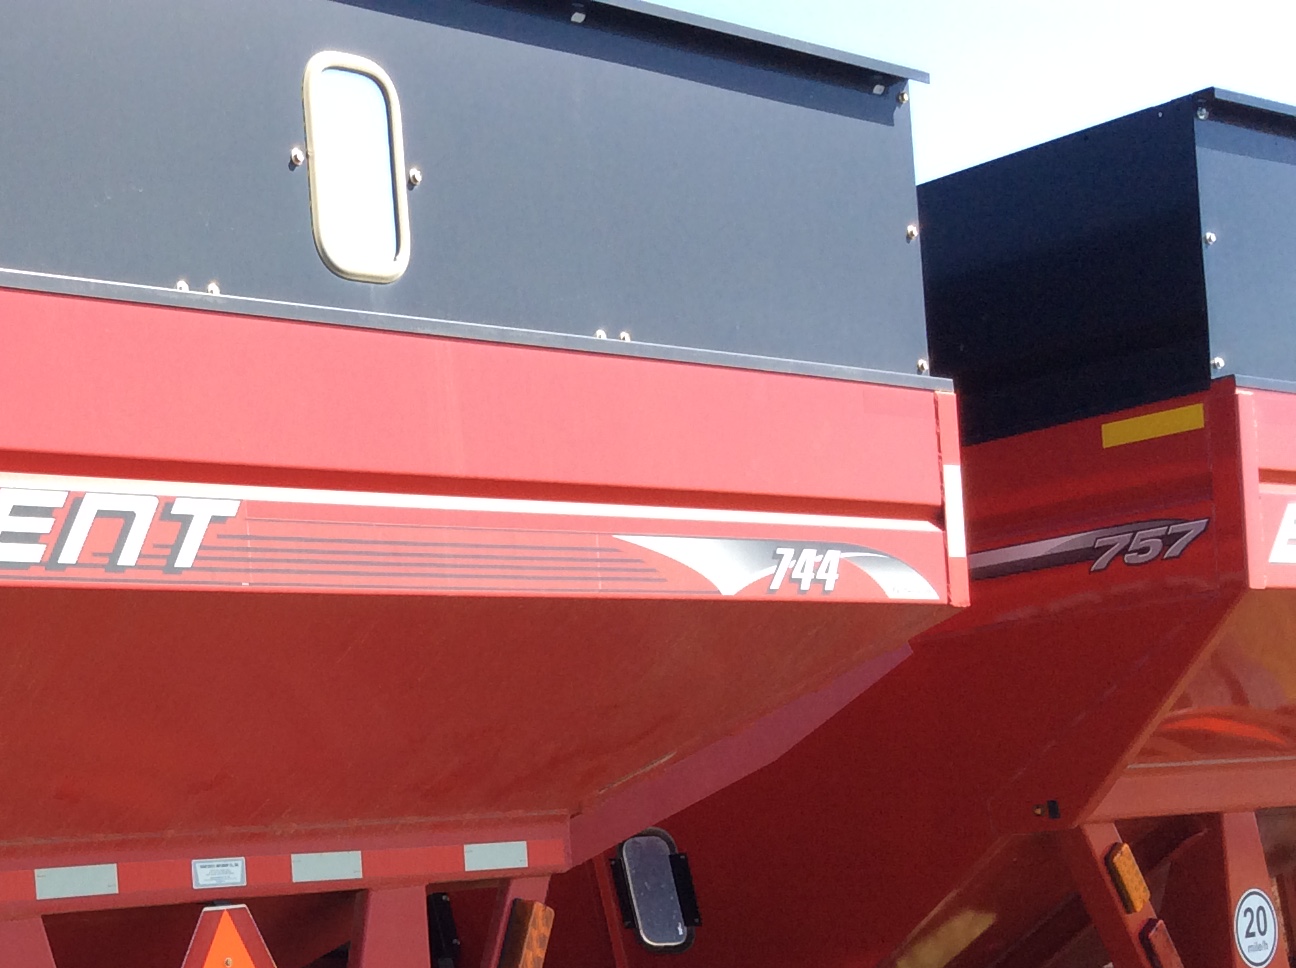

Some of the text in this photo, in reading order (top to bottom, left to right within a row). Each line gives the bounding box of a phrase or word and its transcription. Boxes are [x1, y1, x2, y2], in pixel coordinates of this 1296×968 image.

[1089, 518, 1210, 574] 757
[766, 547, 841, 594] 744
[1244, 905, 1268, 939] 20
